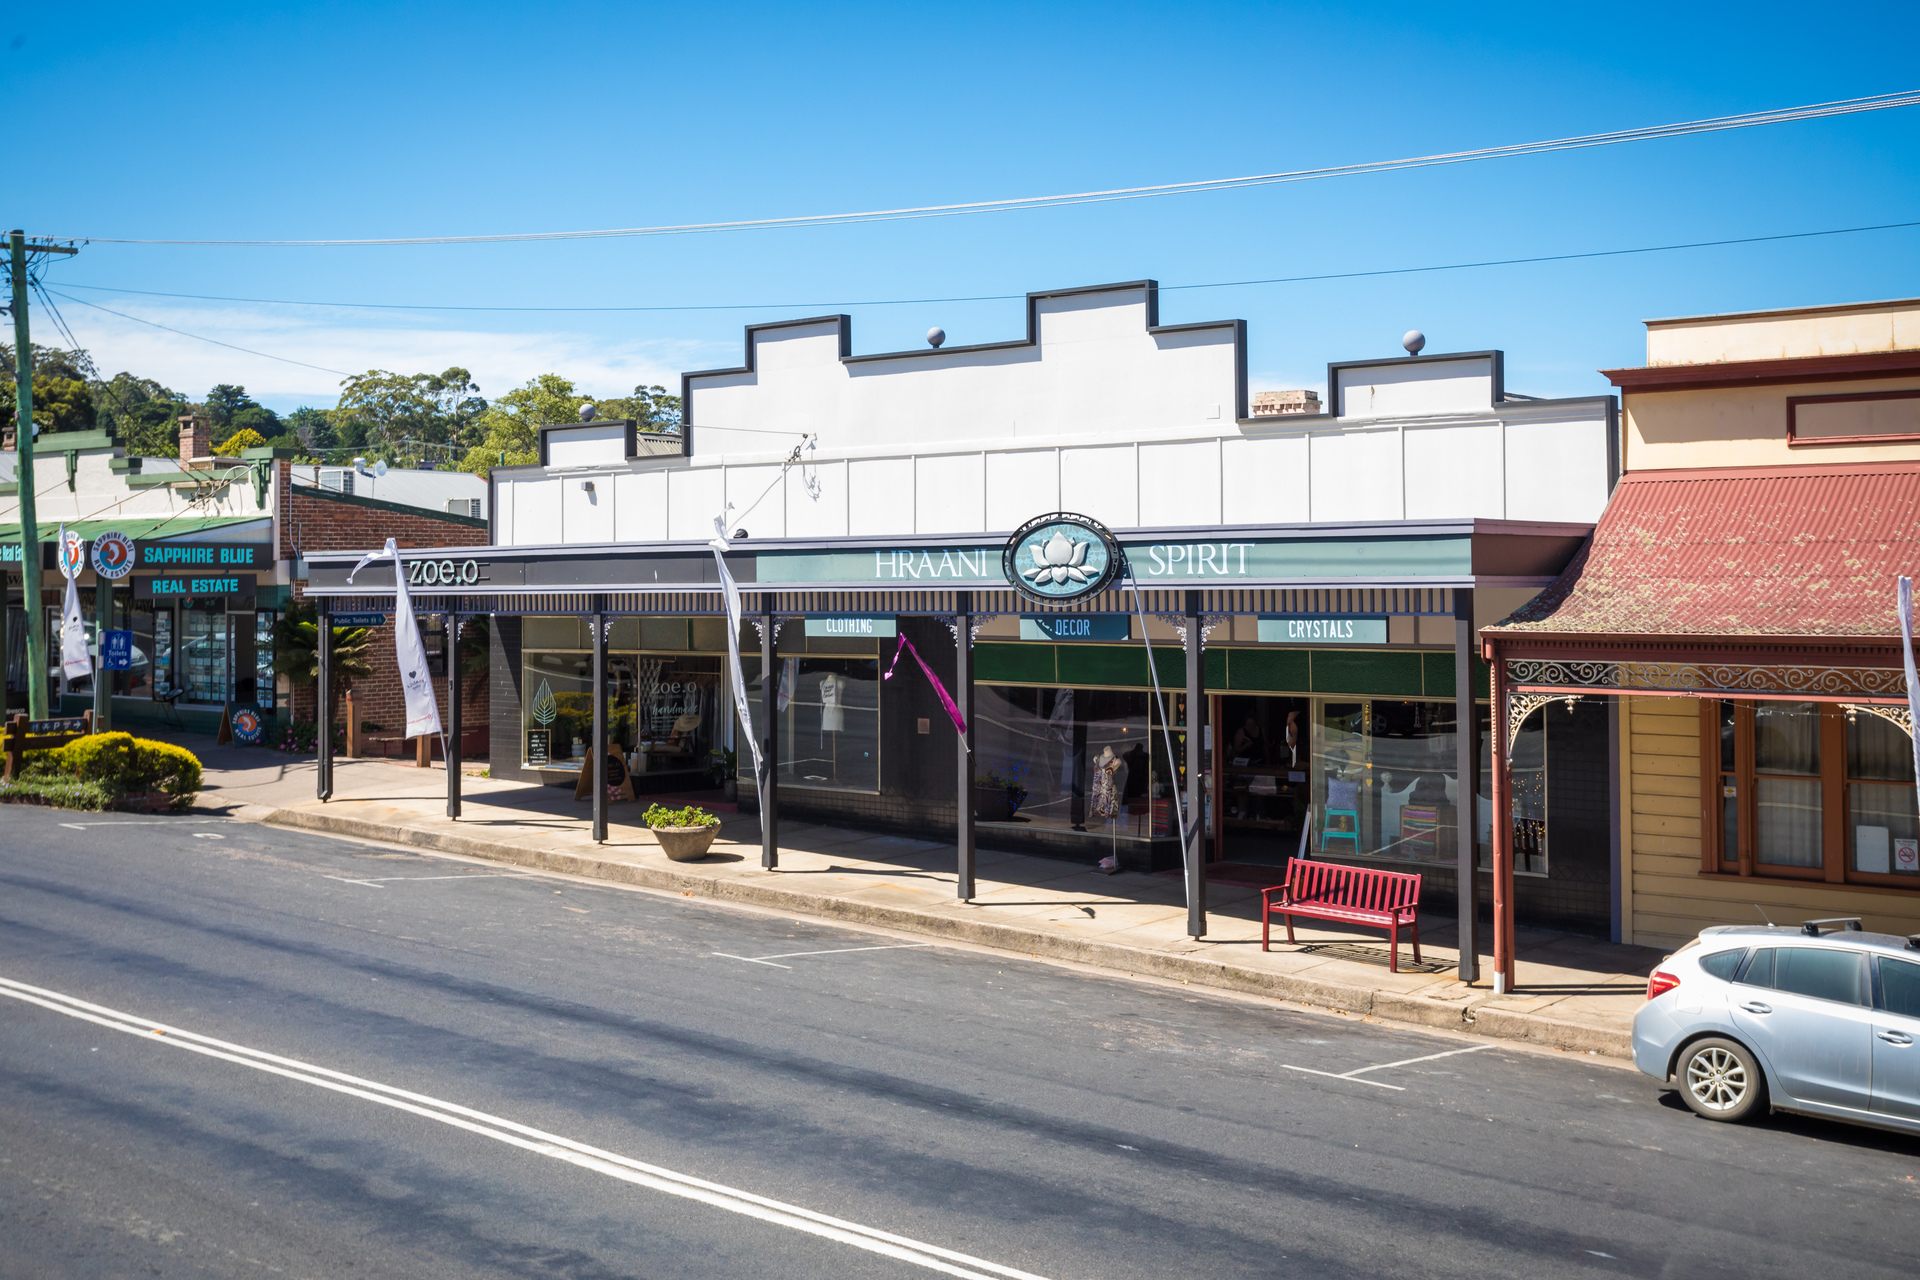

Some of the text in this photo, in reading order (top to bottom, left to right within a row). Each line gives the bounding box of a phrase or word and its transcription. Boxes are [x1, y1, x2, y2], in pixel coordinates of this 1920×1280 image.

[144, 547, 253, 564] SAPPHIRE BLUE
[875, 548, 987, 579] HRAANI
[1148, 542, 1255, 576] SPIRIT
[94, 559, 133, 577] REAL ESTATE
[409, 559, 478, 584] zoe.o
[152, 578, 238, 594] REAL ESTATE
[826, 618, 872, 634] CLOTHING
[1055, 619, 1091, 636] DECOR
[1288, 620, 1353, 638] CRYSTALS
[651, 681, 697, 694] zoe.o
